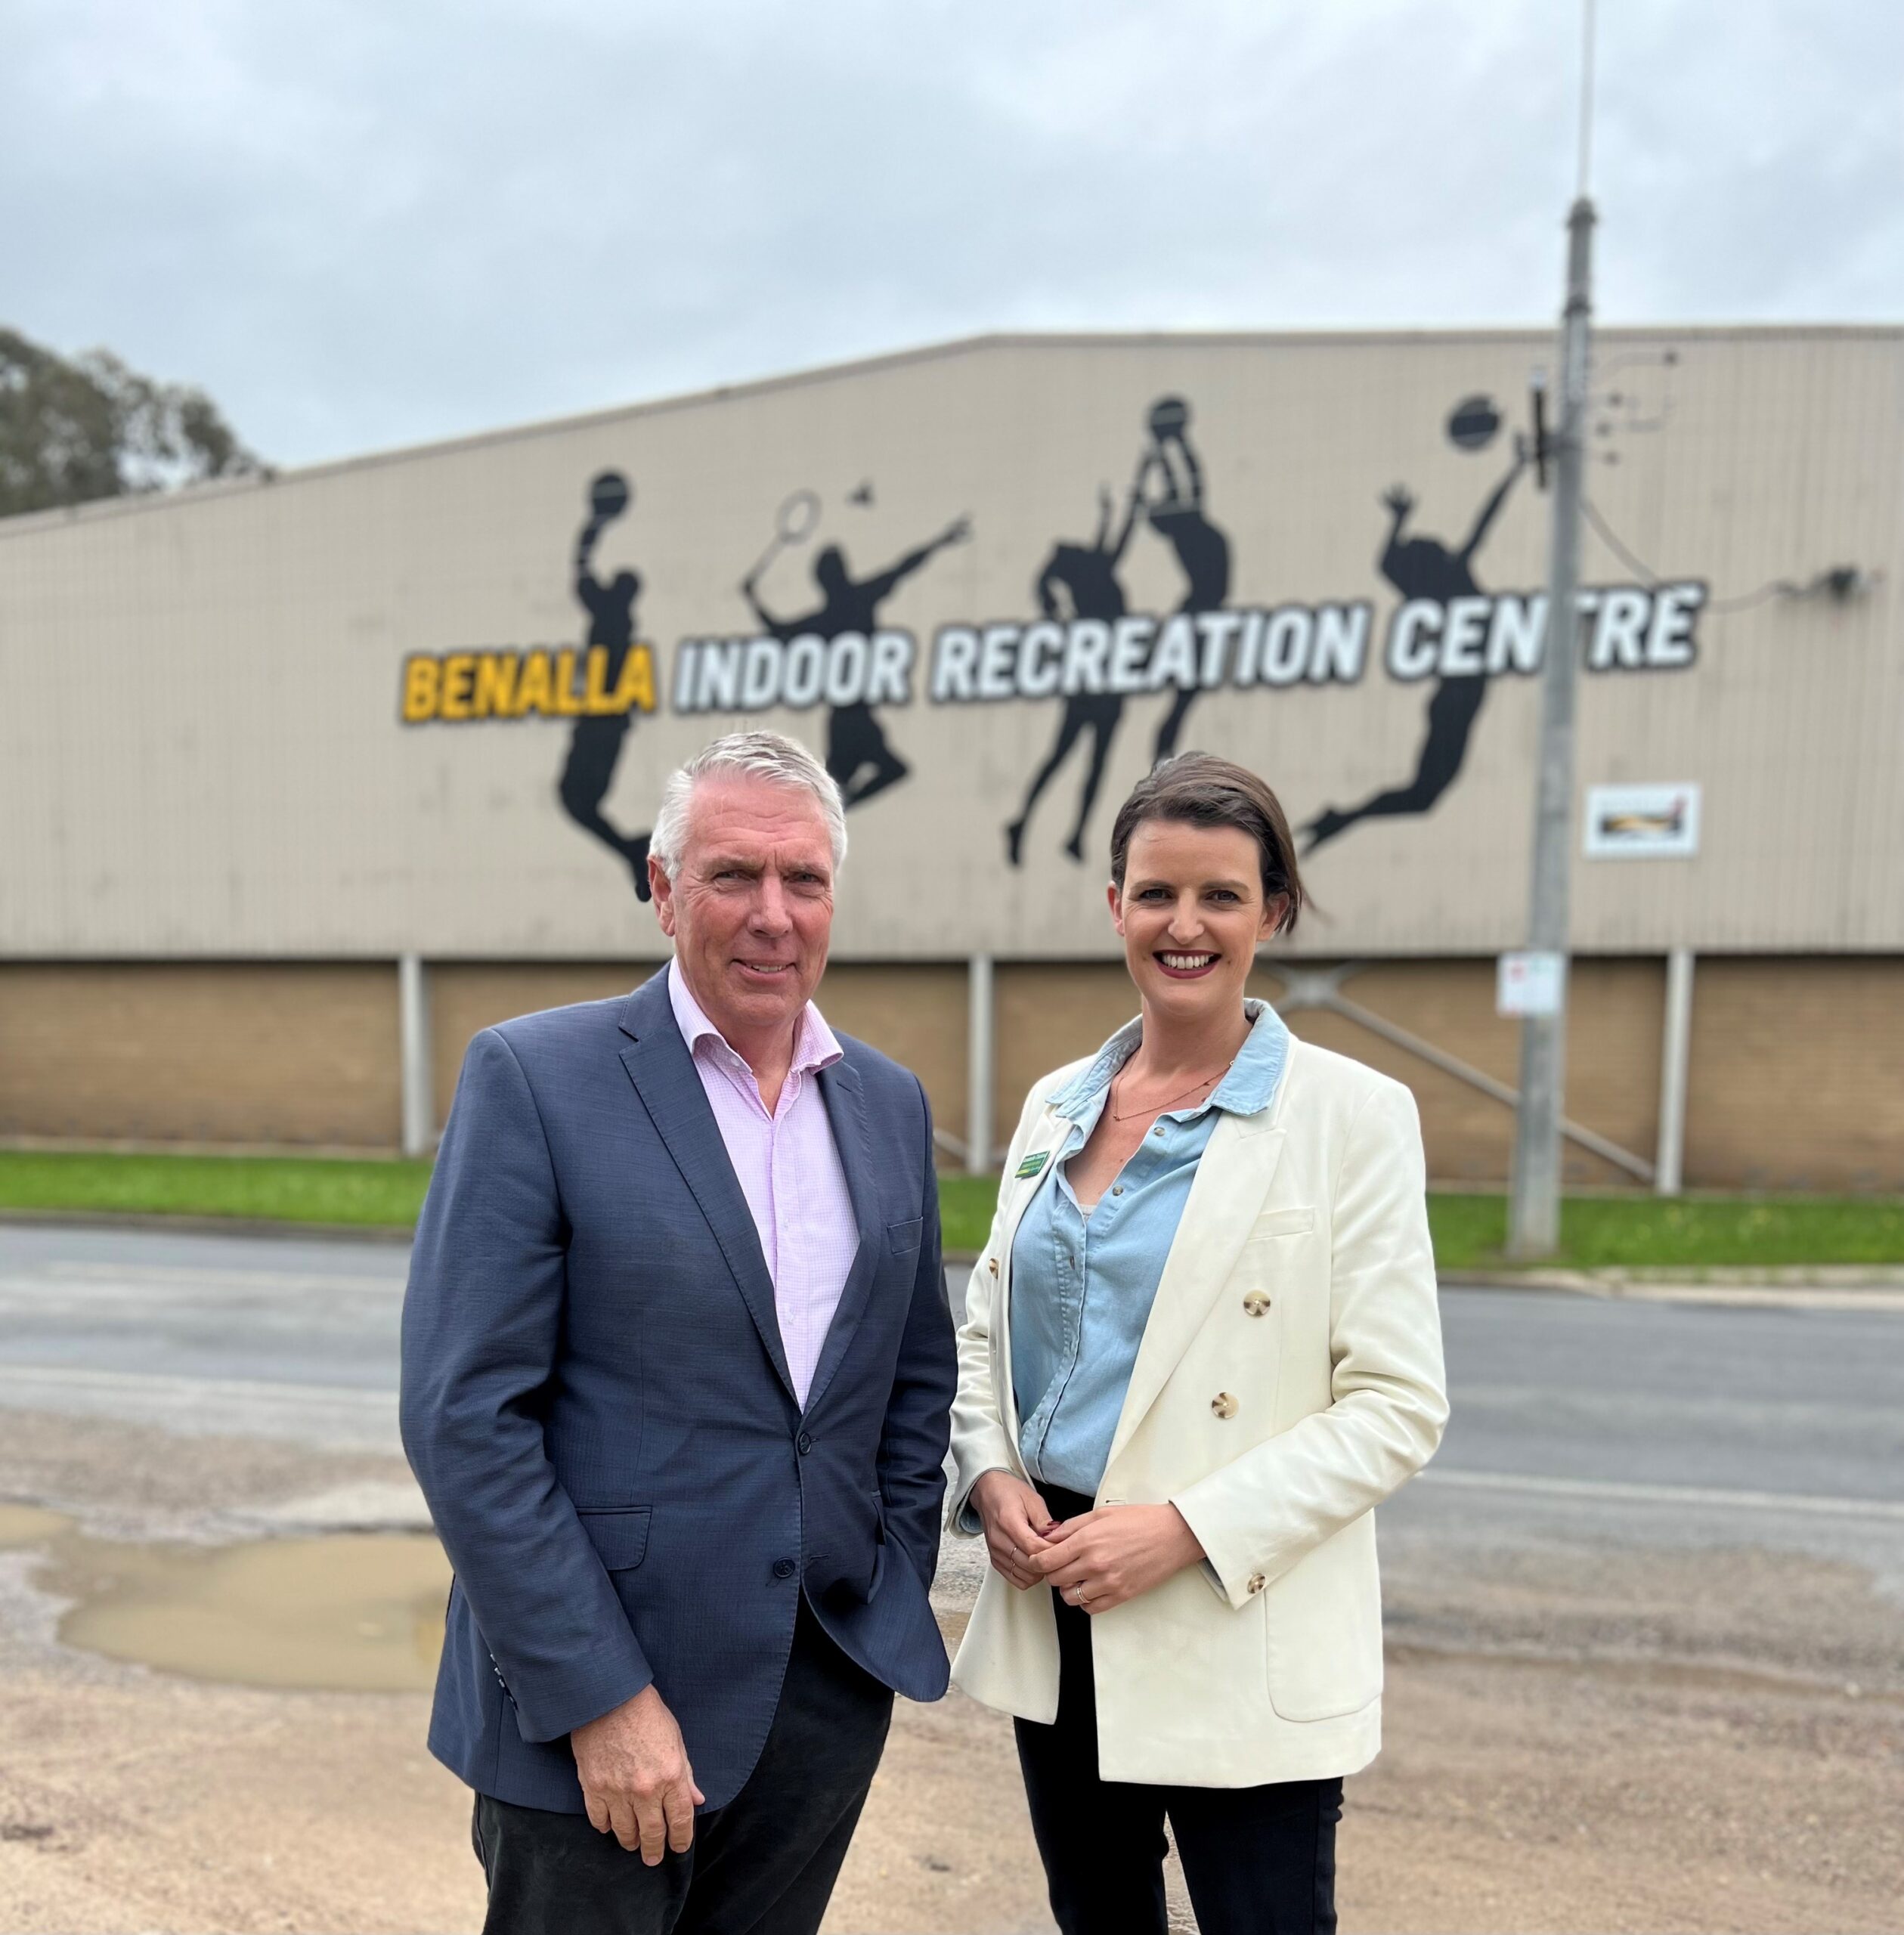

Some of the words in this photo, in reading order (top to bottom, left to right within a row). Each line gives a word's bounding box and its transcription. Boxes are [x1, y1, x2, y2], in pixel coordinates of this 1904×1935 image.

[402, 645, 655, 722] BENALLA
[676, 630, 912, 712] INDOOR
[932, 606, 1369, 700] RECREATION
